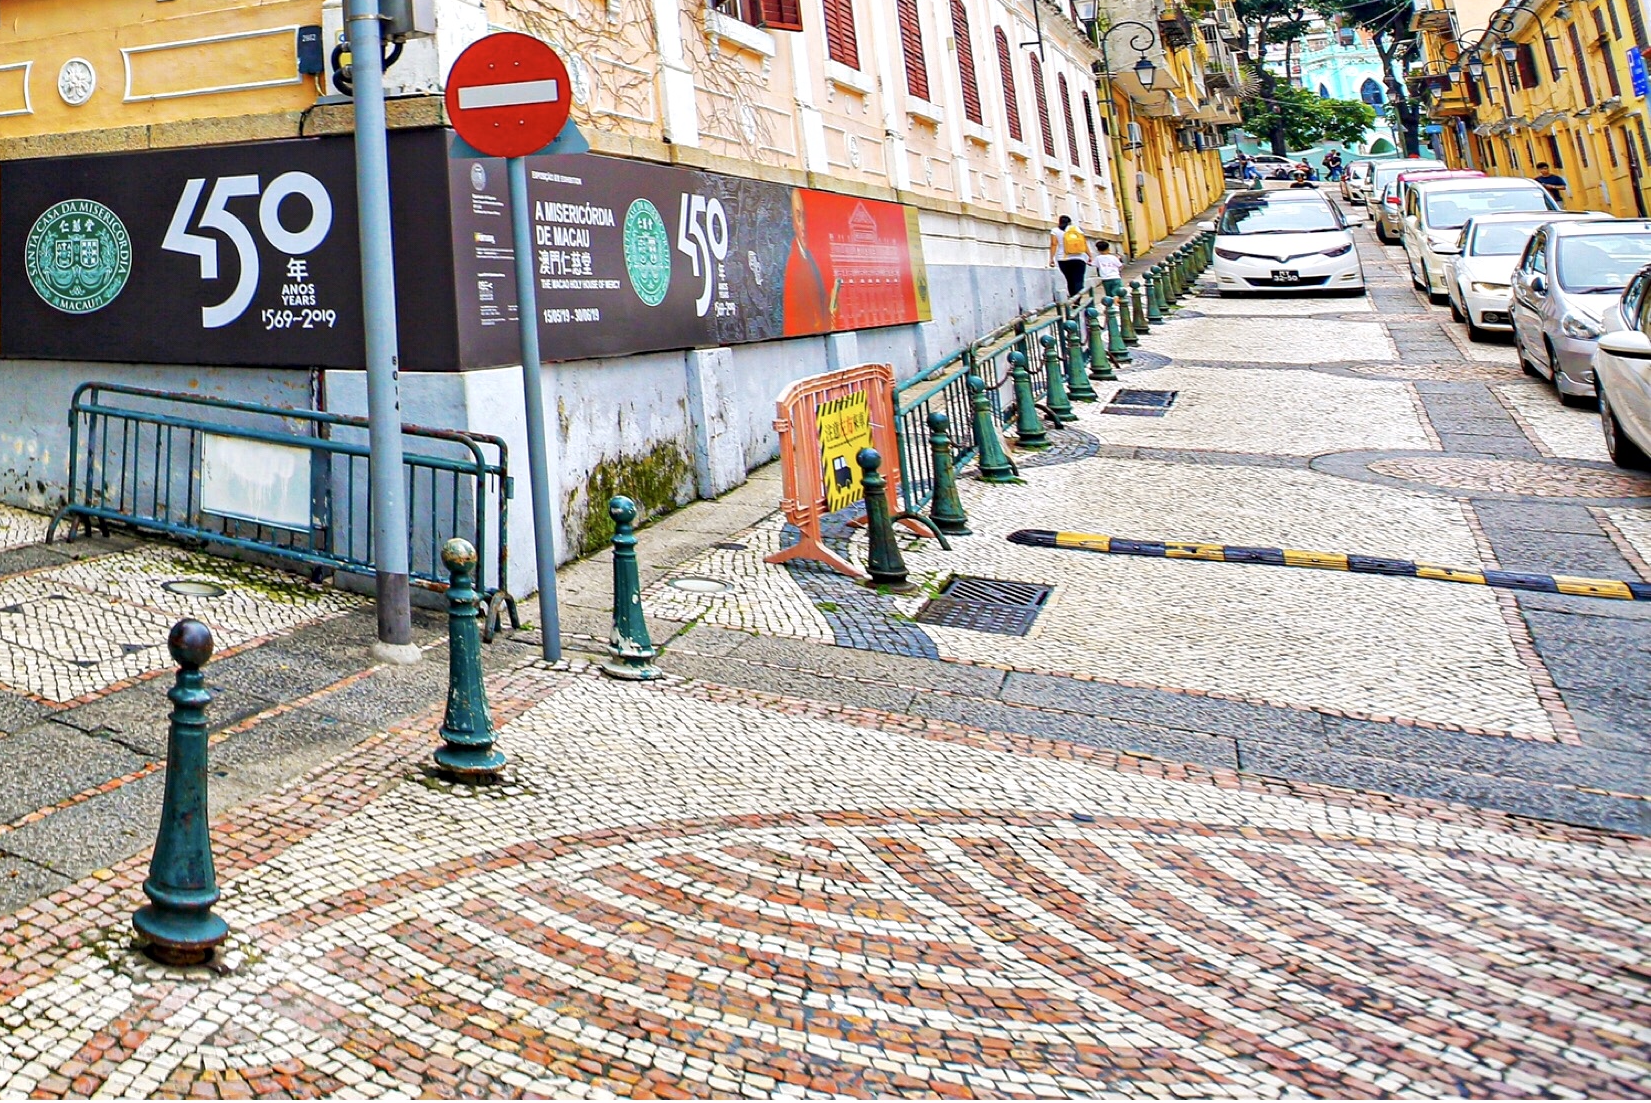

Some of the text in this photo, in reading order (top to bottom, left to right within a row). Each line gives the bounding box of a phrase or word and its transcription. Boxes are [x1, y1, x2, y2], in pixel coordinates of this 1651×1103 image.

[535, 200, 616, 227] A MISERICÓRDIA
[27, 202, 129, 276] SANTA CASA DA MISERICORDIA
[535, 224, 590, 247] DE MACAU
[161, 170, 333, 328] 450
[677, 192, 728, 317] 450
[286, 257, 309, 283] 年
[538, 249, 593, 276] 澳門仁慈堂
[281, 283, 315, 295] ANOS
[281, 295, 316, 306] YEARS
[59, 298, 95, 310] MACAU
